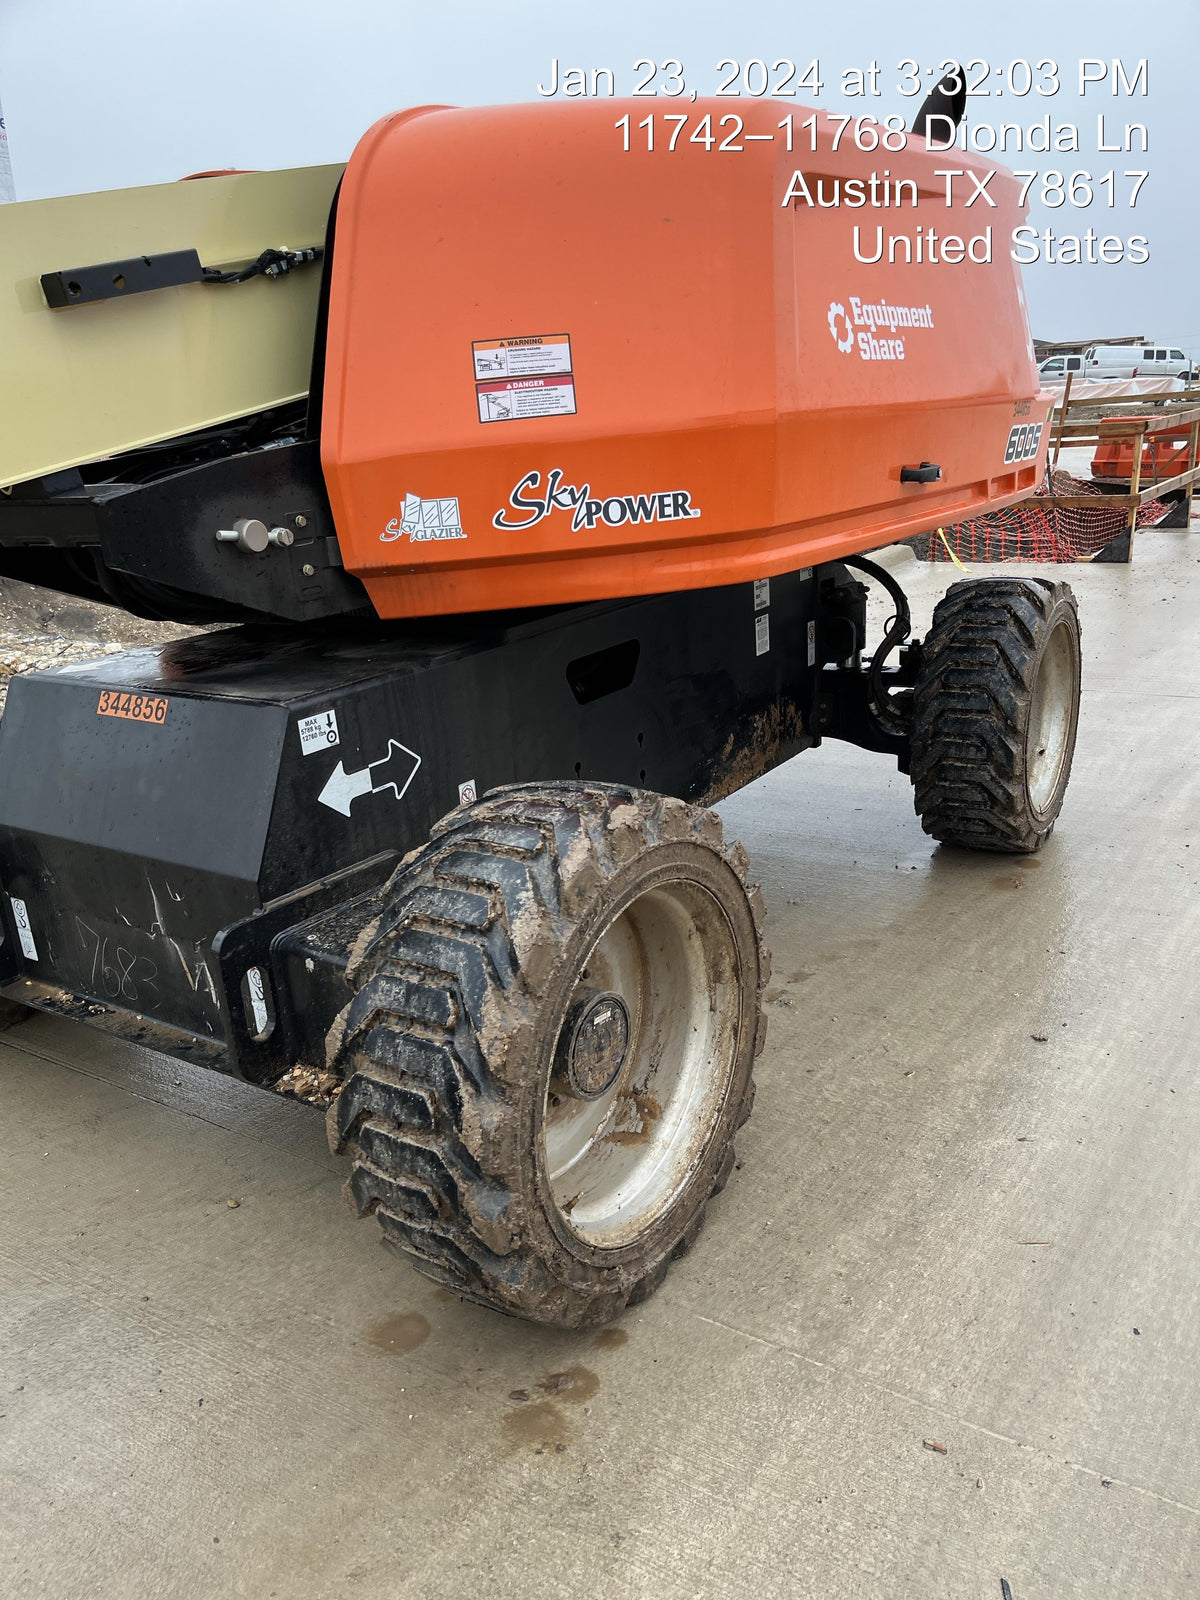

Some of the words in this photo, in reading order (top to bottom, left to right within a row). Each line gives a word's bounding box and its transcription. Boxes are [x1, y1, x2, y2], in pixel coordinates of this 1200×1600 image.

[849, 297, 934, 333] Equipment
[507, 338, 543, 347] WARNING
[857, 332, 905, 360] Share
[512, 380, 545, 389] DANGER
[99, 690, 167, 722] 344856
[304, 719, 318, 727] MAX
